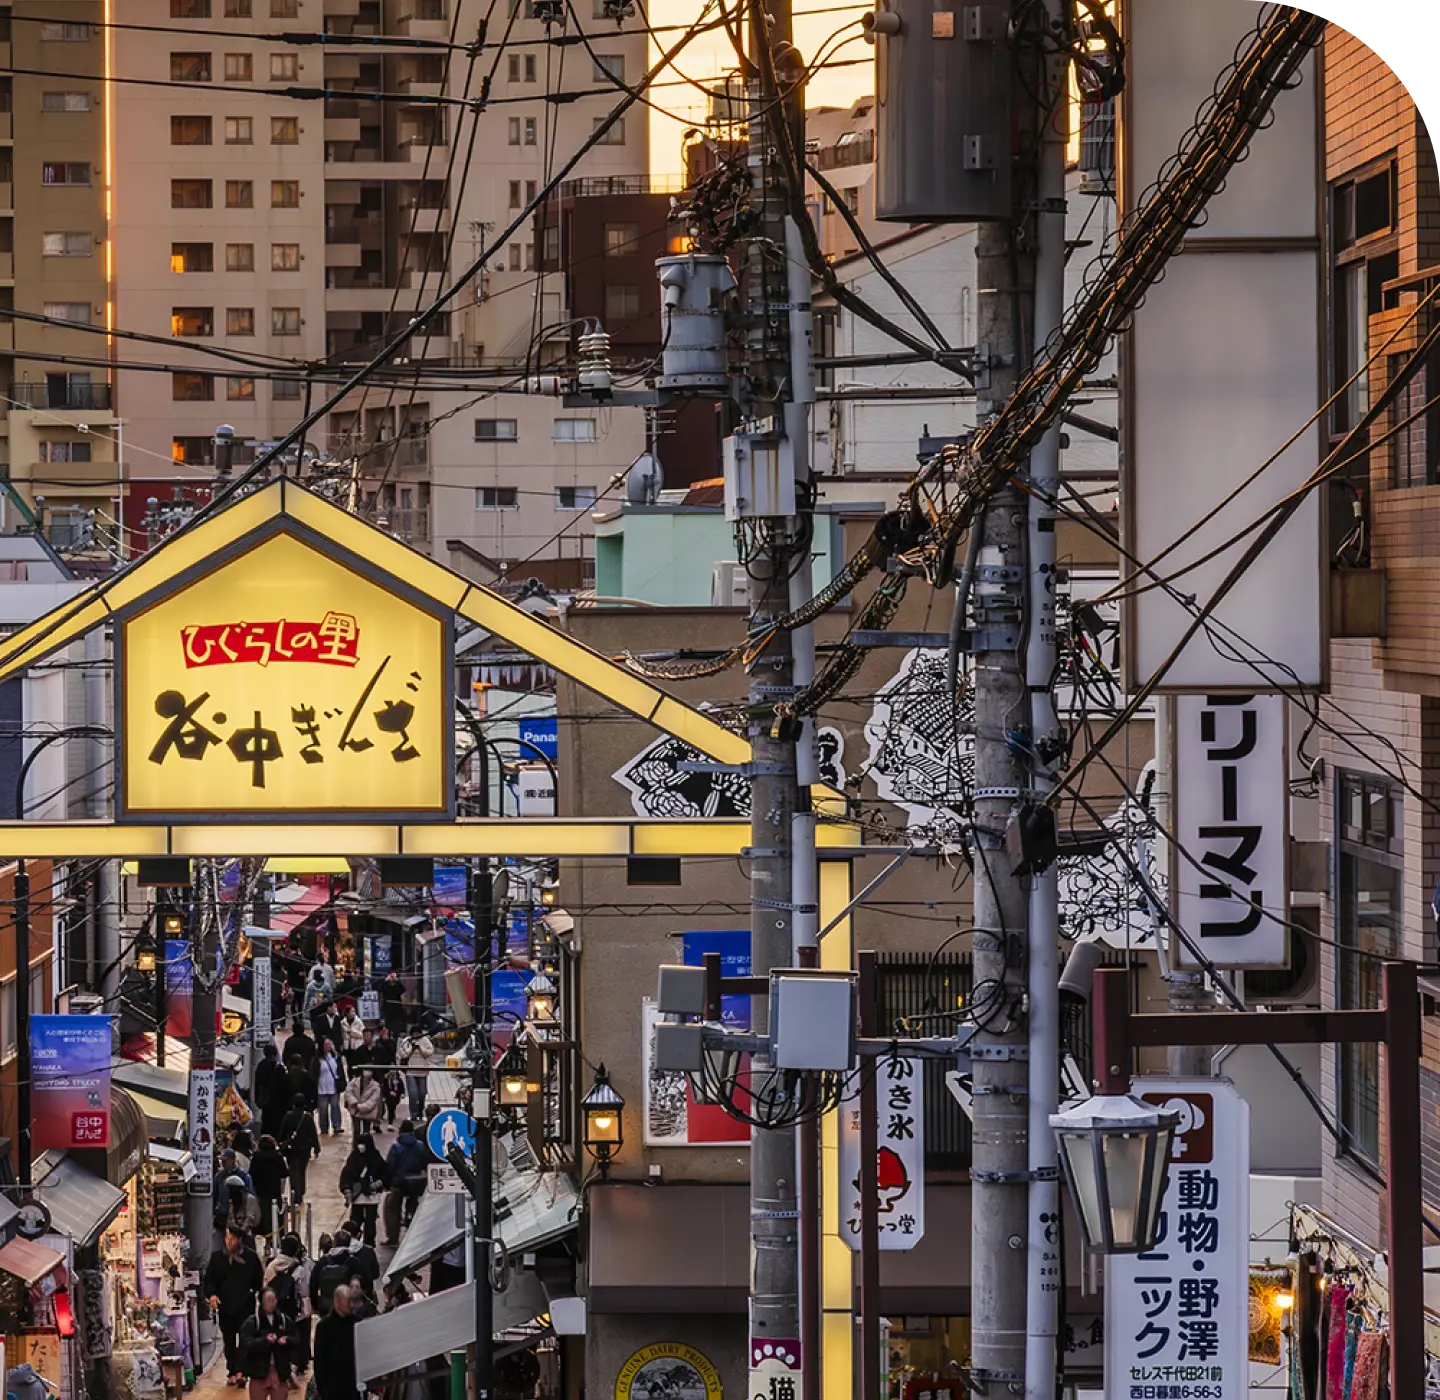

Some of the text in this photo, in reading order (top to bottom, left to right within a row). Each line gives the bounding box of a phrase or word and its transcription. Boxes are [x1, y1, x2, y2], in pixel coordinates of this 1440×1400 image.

[184, 611, 360, 668] ひぐらしの里
[148, 655, 422, 789] 谷中ぎんざ
[523, 731, 558, 743] Pana
[196, 1084, 210, 1125] かき氷
[886, 1055, 915, 1141] かき氷
[75, 1129, 102, 1139] ぎんざ
[76, 1116, 103, 1128] 谷中
[846, 1213, 916, 1235] ひつ堂
[1177, 1168, 1219, 1361] 動物・野澤
[619, 1353, 648, 1394] GENUINE
[683, 1348, 719, 1394] PRODUCTS
[1129, 1365, 1223, 1381] セレス千代田21前
[1129, 1385, 1223, 1400] 西日暮里6-56-3
